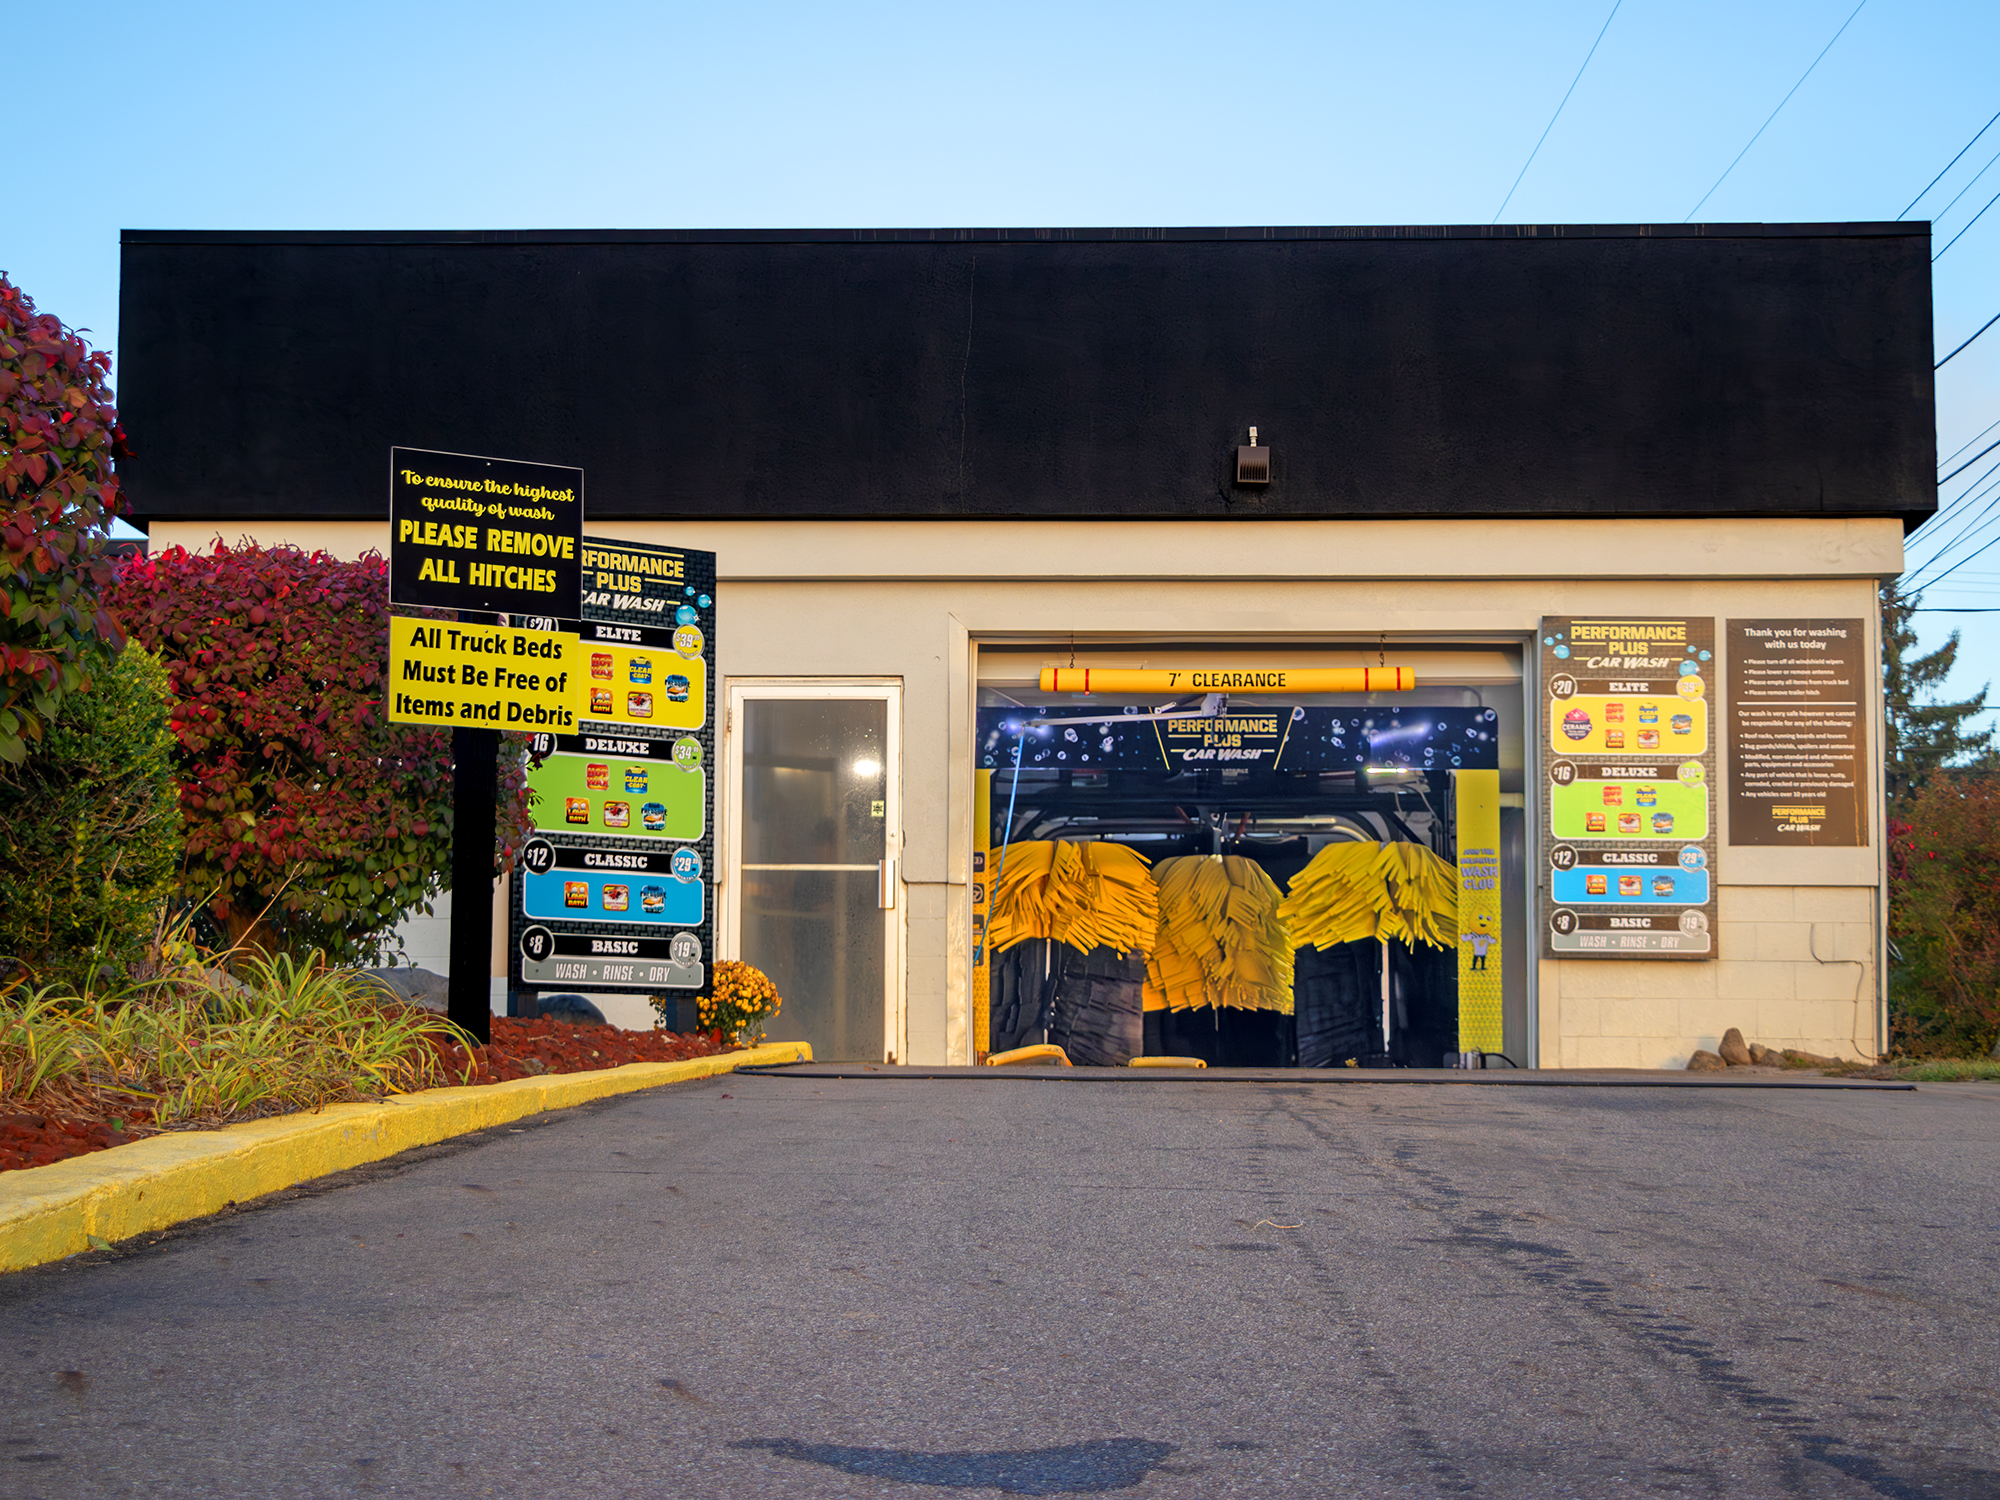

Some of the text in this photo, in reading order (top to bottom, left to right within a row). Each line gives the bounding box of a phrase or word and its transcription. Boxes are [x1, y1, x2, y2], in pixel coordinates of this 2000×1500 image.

[400, 469, 575, 502] To ensure the highest
[421, 497, 555, 520] quality of wash
[400, 519, 575, 559] PLEASE REMOVE
[582, 549, 684, 578] FORMANCE
[418, 558, 557, 593] ALL HITCHES
[596, 572, 641, 593] PLUS
[612, 594, 665, 611] WASH
[530, 617, 553, 631] $20
[596, 625, 641, 641] ELITE
[1571, 626, 1687, 640] PERFORMANCE
[1744, 628, 1847, 638] Thank you for washing
[410, 627, 562, 659] All Truck Beds
[1608, 642, 1649, 655] PLUS
[1764, 640, 1827, 650] with us today
[592, 657, 613, 667] HOT
[1587, 656, 1670, 669] CAR WASH
[403, 659, 567, 692] Must Be Free of
[591, 666, 614, 677] WAX
[1192, 673, 1286, 687] CLEARANCE
[1608, 682, 1649, 692] ELITE
[1553, 680, 1573, 695] $20
[396, 693, 573, 726] Items and Debris
[1168, 719, 1278, 732] PERFORMANCE
[1562, 723, 1592, 731] CERAMIC
[585, 738, 650, 755] DELUXE
[1204, 734, 1241, 747] PLUS
[1183, 748, 1262, 761] CAR WASH
[587, 767, 609, 776] HOT
[1553, 766, 1572, 780] $16
[1601, 767, 1657, 777] DELUXE
[586, 776, 610, 787] WAX
[624, 775, 648, 783] CLEAR
[1772, 808, 1826, 816] PERFORMANCE
[1777, 824, 1821, 832] CAR WASH
[527, 848, 548, 867] $12
[584, 853, 648, 868] CLASSIC
[1554, 851, 1572, 865] $12
[1602, 853, 1658, 863] CLASSIC
[1461, 866, 1498, 878] WASH
[1463, 878, 1495, 890] CLUB
[1557, 915, 1570, 930] $8
[1609, 917, 1651, 927] BASIC
[530, 935, 544, 954] $8
[592, 940, 638, 954] BASIC
[1580, 935, 1680, 948] WASH RINSE DRY
[555, 963, 670, 982] WASH RINSE DRY
